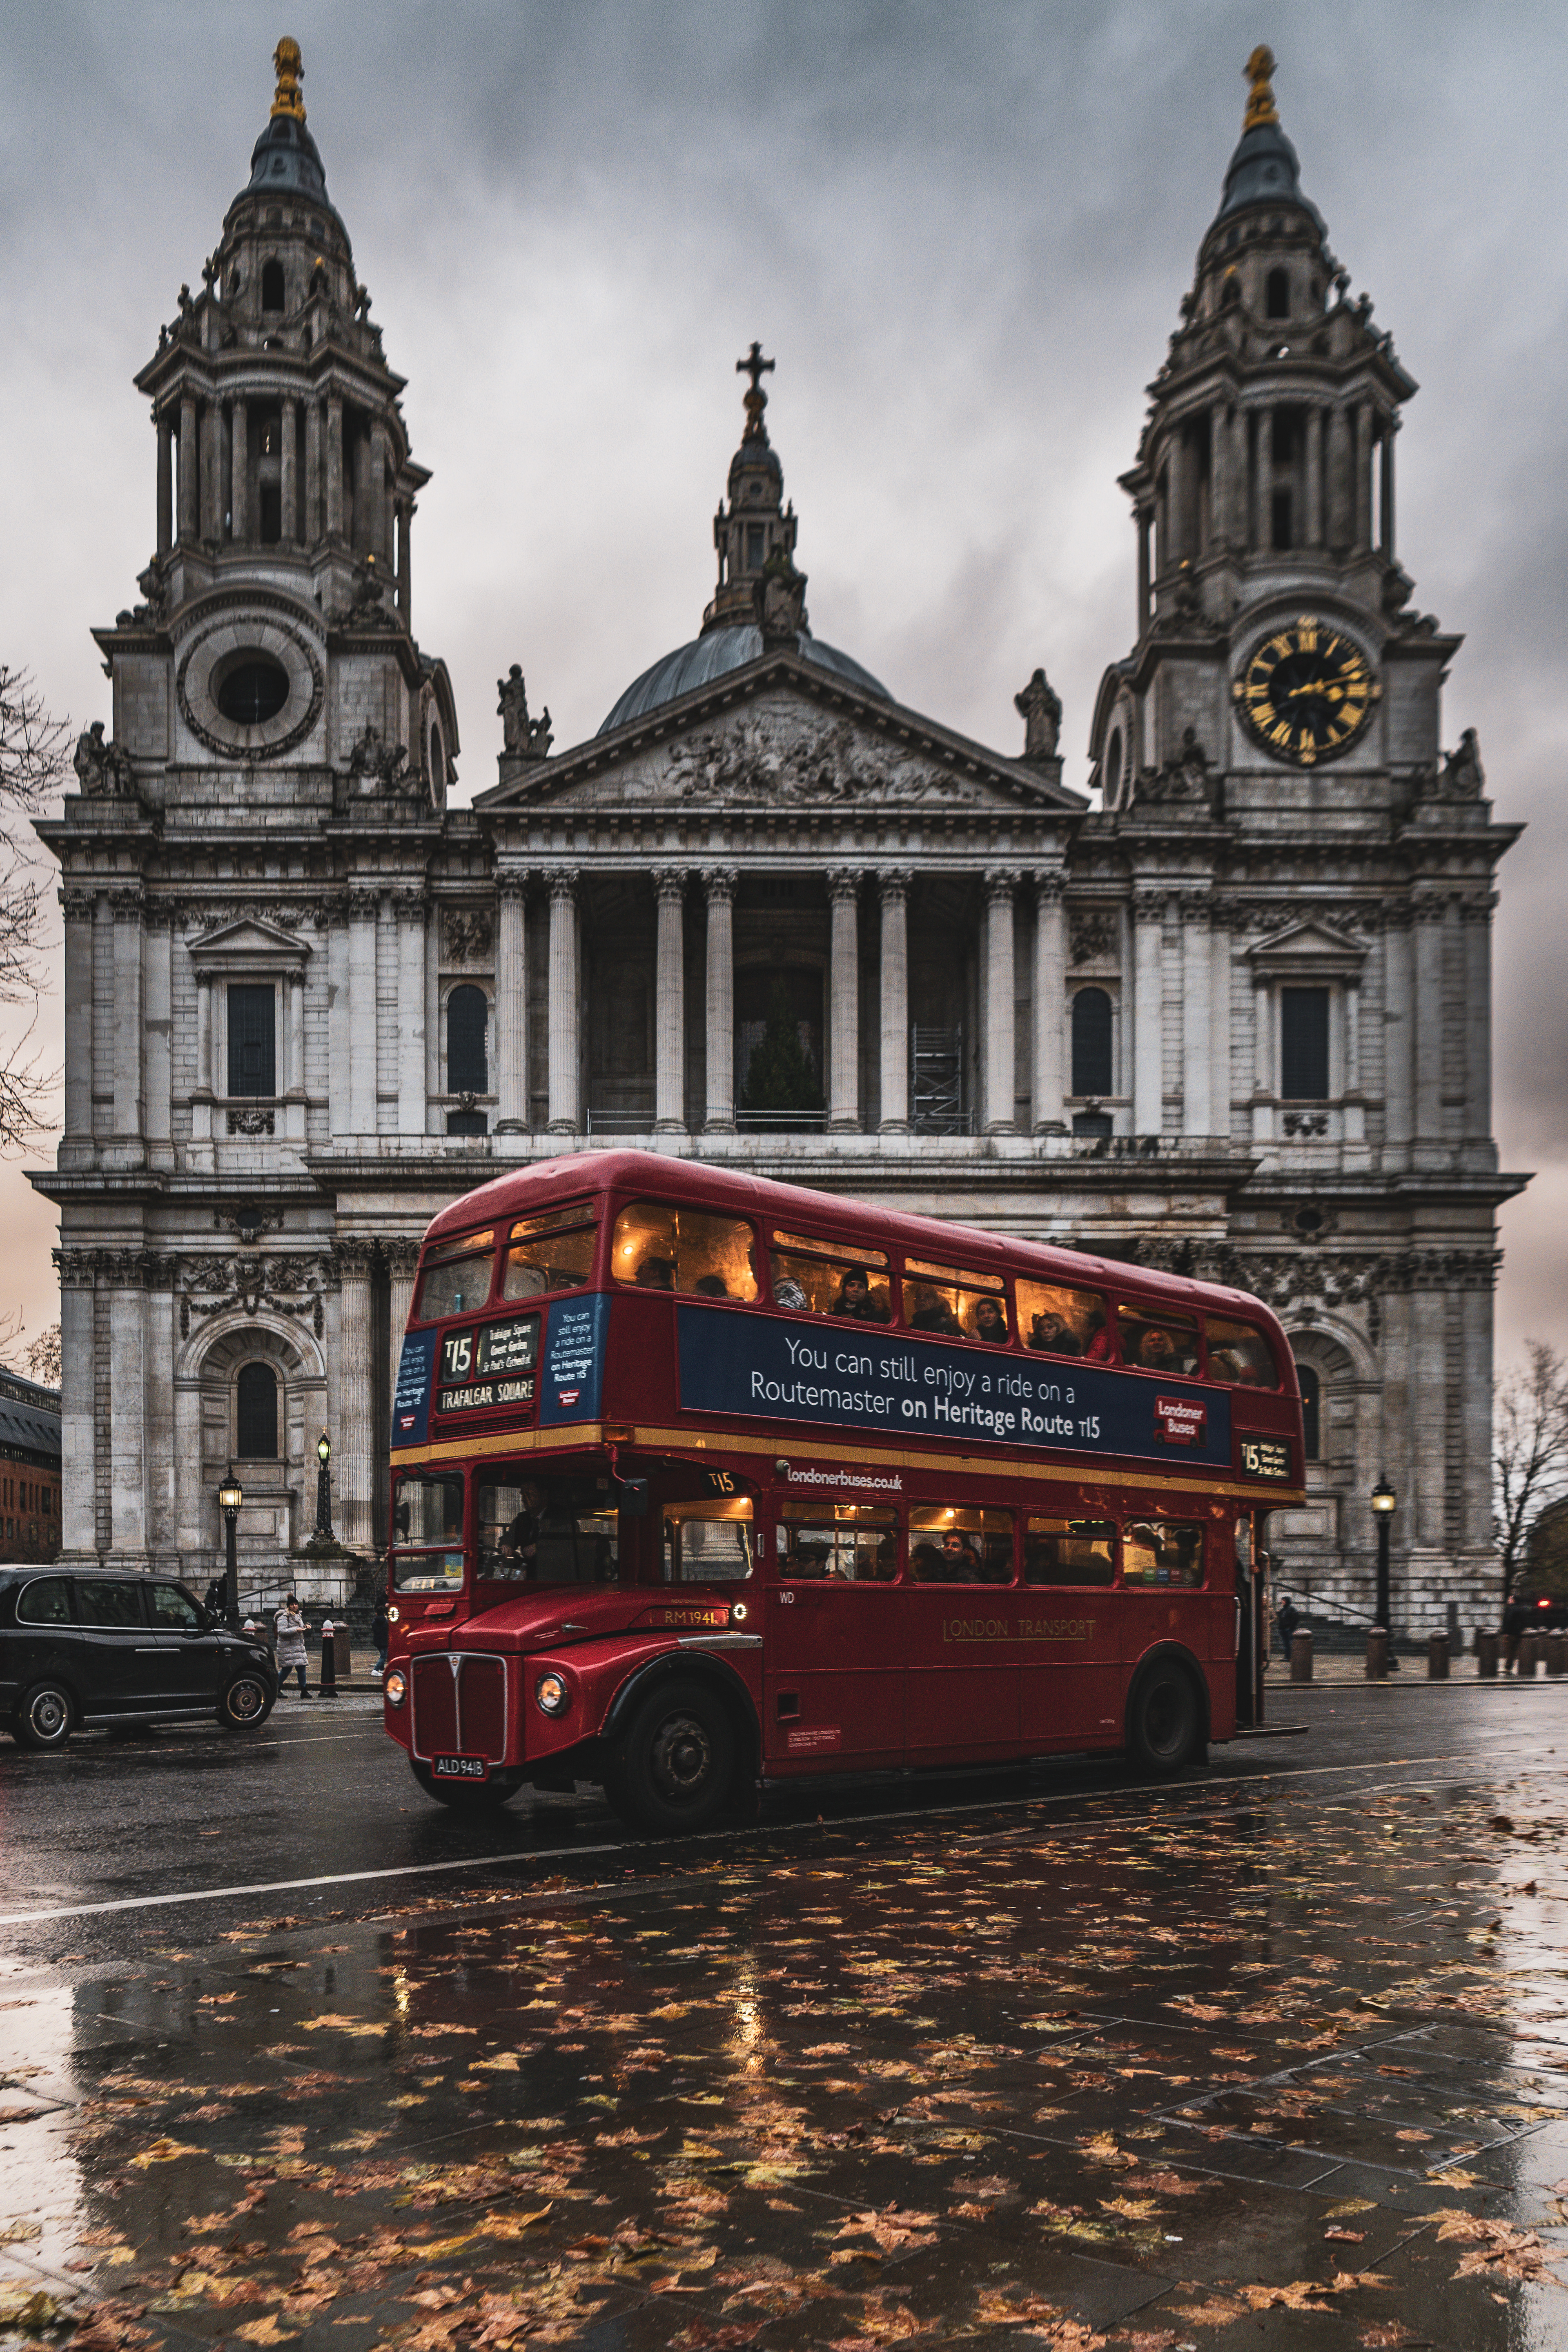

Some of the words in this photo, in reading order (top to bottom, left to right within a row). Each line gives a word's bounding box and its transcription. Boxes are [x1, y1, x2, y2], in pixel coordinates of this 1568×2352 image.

[445, 1337, 472, 1372] T15
[561, 1359, 592, 1369] Heritage
[554, 1373, 575, 1382] Route
[785, 1337, 826, 1369] You
[835, 1354, 872, 1375] can
[880, 1356, 918, 1382] still
[924, 1365, 976, 1396] enjoy
[981, 1375, 991, 1392] a
[998, 1374, 1033, 1398] ride
[1038, 1383, 1060, 1401] on
[1066, 1388, 1075, 1403] a
[443, 1386, 492, 1409] TRAFALGAR
[497, 1380, 534, 1401] SQUARE
[752, 1371, 894, 1414] Routemaster
[902, 1399, 927, 1418] on
[934, 1396, 1016, 1436] Heritage
[1021, 1407, 1074, 1435] Route
[1078, 1417, 1100, 1439] T15
[1158, 1400, 1203, 1420] Londoner
[708, 1472, 735, 1492] T15
[780, 1592, 795, 1604] WD
[943, 1619, 1008, 1642] LONDON
[1018, 1619, 1096, 1640] TRANSPORT
